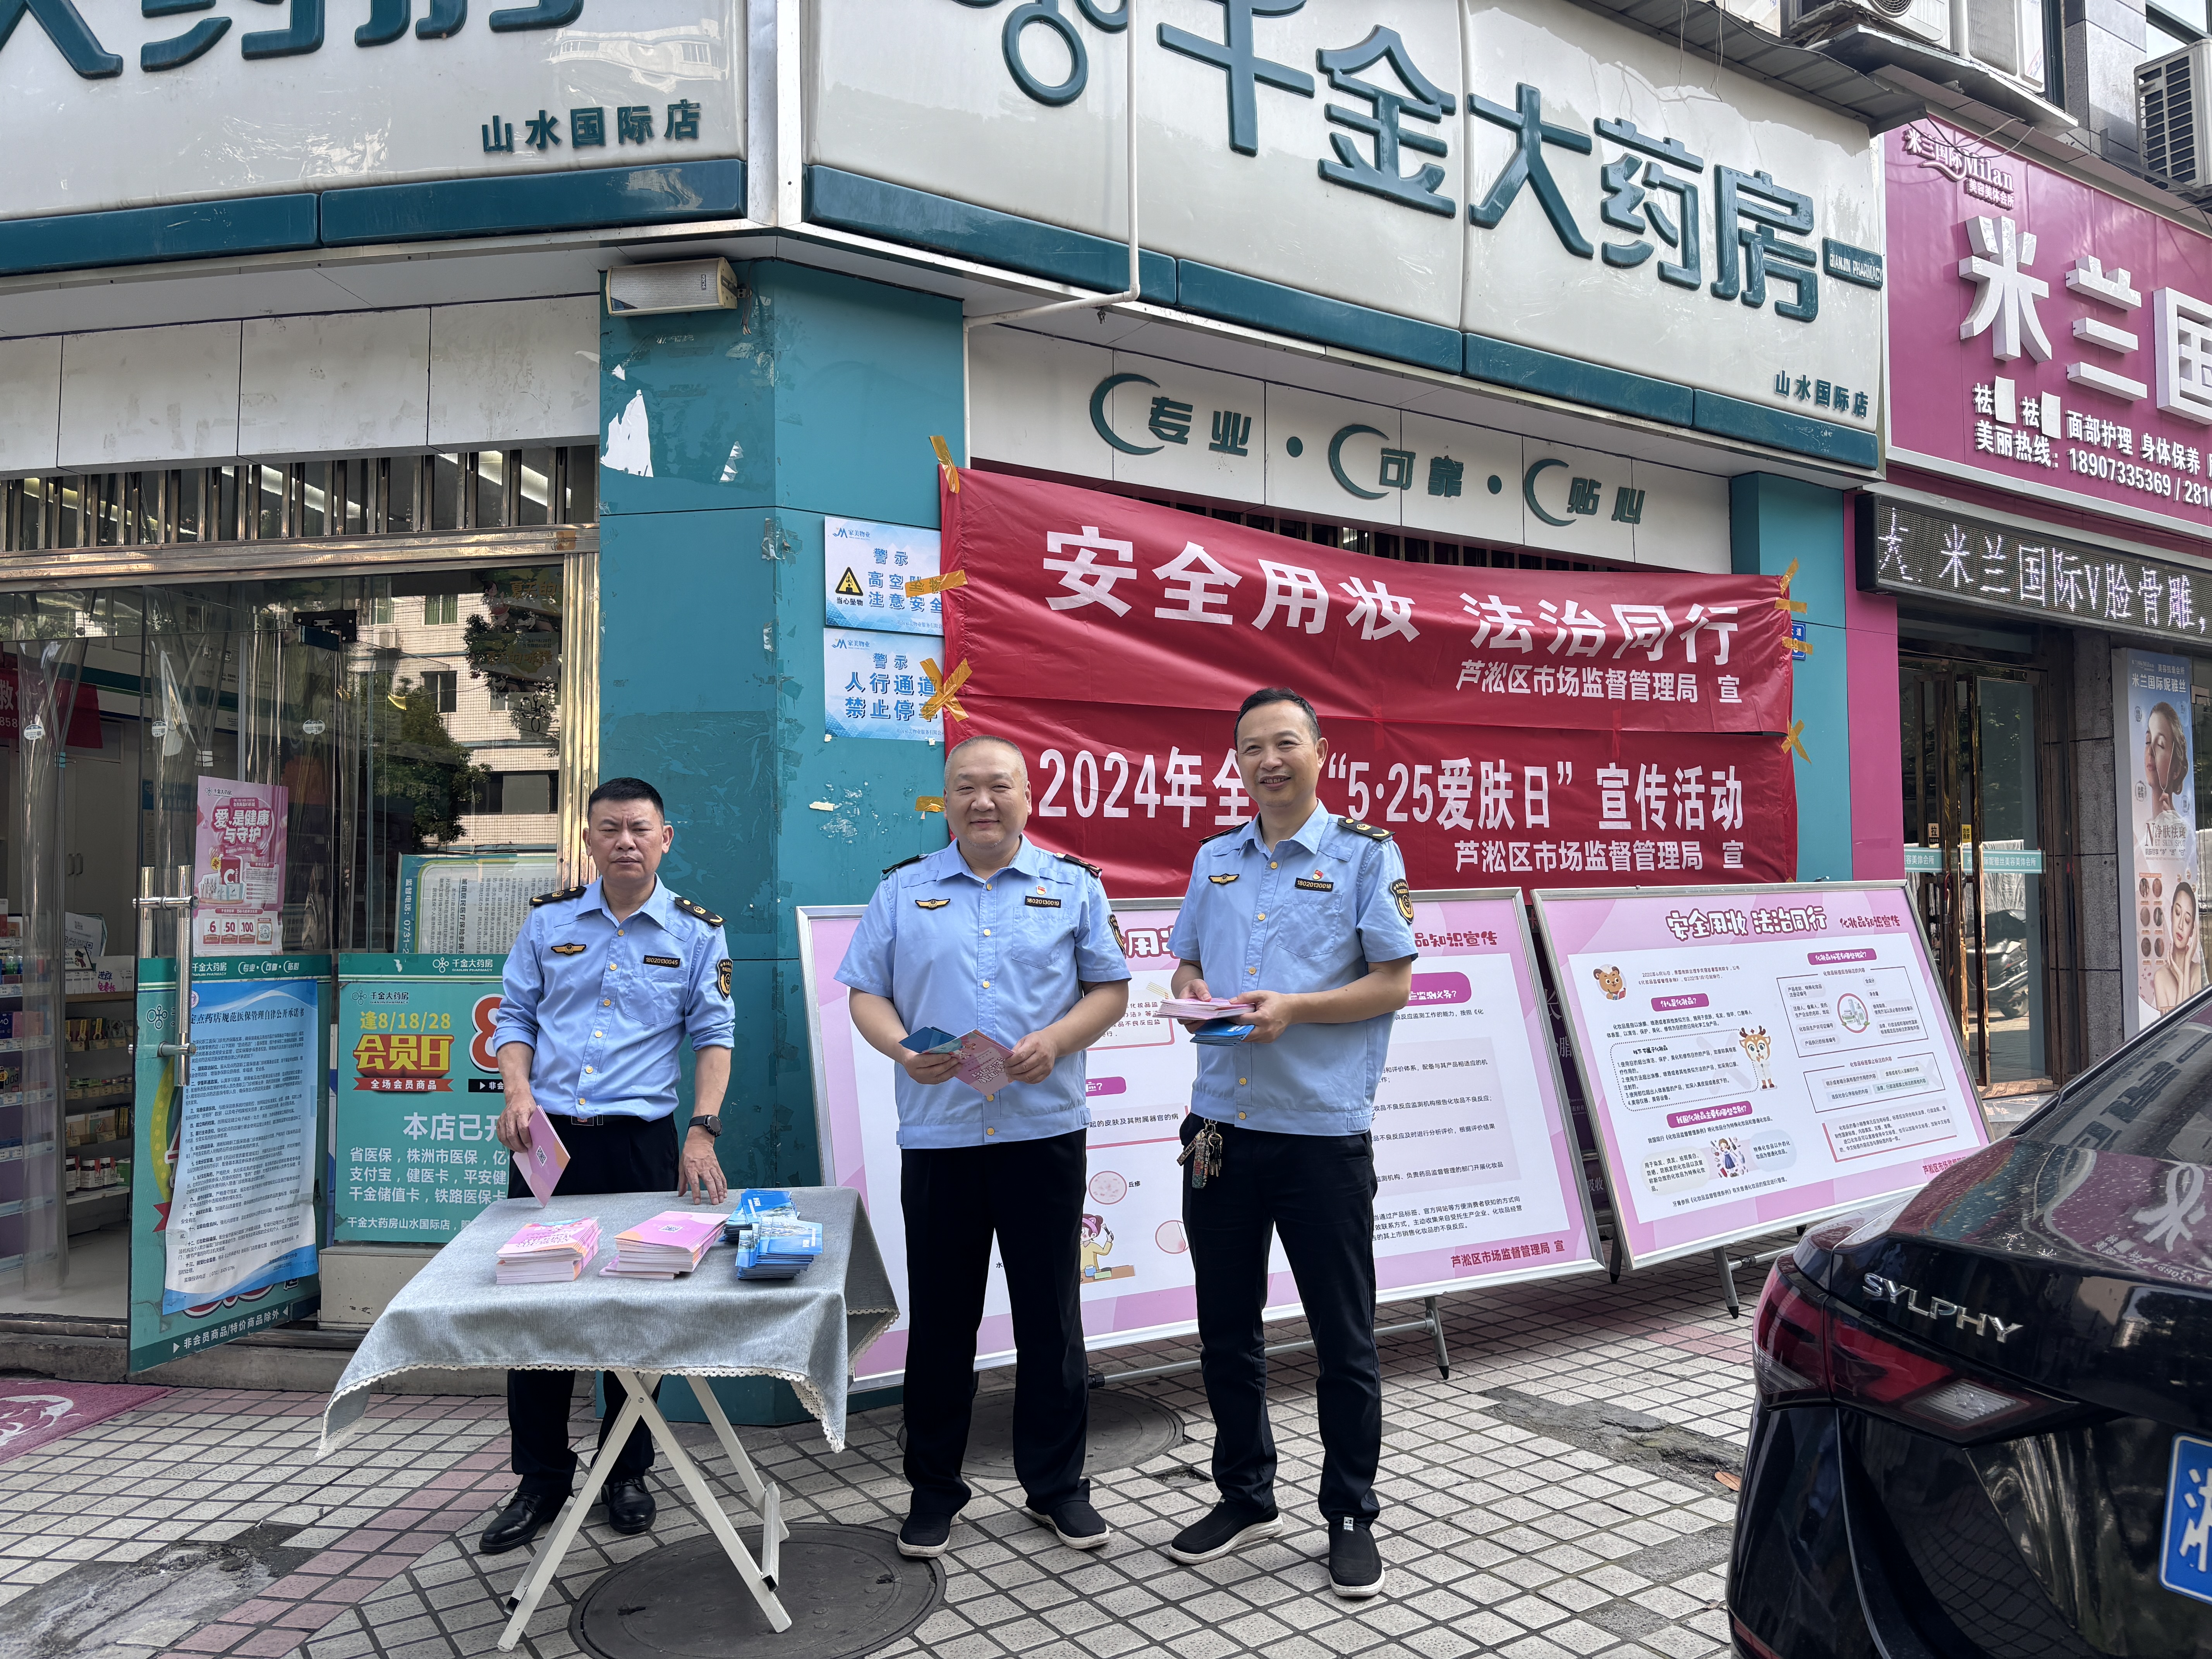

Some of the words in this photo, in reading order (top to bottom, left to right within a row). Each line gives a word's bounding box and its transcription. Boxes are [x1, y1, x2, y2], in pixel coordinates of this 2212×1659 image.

[481, 98, 701, 155] 山水国际店
[1156, 0, 1818, 322] 千金大药房
[1962, 148, 2014, 192] Milan
[1969, 178, 2014, 208] 美容美体会所
[1830, 253, 1851, 273] QIANJIN
[1853, 260, 1883, 282] PHARMACY
[1774, 369, 1869, 419] 山水国际店
[2066, 409, 2133, 456] 面部护理
[2141, 432, 2201, 476] 身体保养
[1147, 394, 1251, 457] 专业
[1379, 446, 1464, 498] 可靠
[1569, 477, 1645, 526] 贴心
[848, 529, 871, 538] 家美物业
[873, 548, 908, 566] 警示
[836, 597, 863, 606] 当心坠物
[868, 591, 942, 613] 注意安全
[1043, 526, 1422, 644] 安全用妆
[1460, 591, 1740, 666] 法治同行
[873, 653, 908, 670] 警示
[845, 672, 937, 697] 人行通道
[1456, 659, 1698, 704] 芦淞区市场监督管理局
[1718, 675, 1742, 704] 宣
[2132, 673, 2186, 692] 米兰国际妮雅丝
[845, 697, 938, 722] 禁止停车
[1596, 761, 1743, 832] 宣传活动
[224, 827, 261, 843] 与守护
[1931, 826, 1937, 836] 拉
[2155, 825, 2186, 839] 净肤祛斑
[1455, 840, 1703, 872] 芦淞区市场监督管理局
[1722, 840, 1743, 870] 宣
[1297, 879, 1332, 889] 18020130018
[1027, 898, 1060, 907] 18020130019
[1666, 908, 1748, 941] 安全用妆
[1751, 905, 1827, 934] 法治同行
[1840, 915, 1900, 929] 化妆品知识宣传
[452, 959, 493, 968] 千金大药房
[645, 957, 679, 966] 18020130045
[370, 991, 409, 1000] 千金大药房
[360, 1011, 451, 1032] 逢8/18/28
[354, 1034, 453, 1070] 会员日
[371, 1079, 437, 1091] 全场会员商品
[1087, 1113, 1179, 1128] 起的皮肤及其附属器官的病
[1373, 1205, 1522, 1231] 效联系方式，主动收集来自受托生产企业、化妆品经营
[1451, 1242, 1550, 1269] 芦淞区市场监督管理局
[1554, 1239, 1565, 1253] 宣
[1863, 1273, 2023, 1343] SYLPHY
[184, 1309, 280, 1349] 非会员商品/特价商品除外
